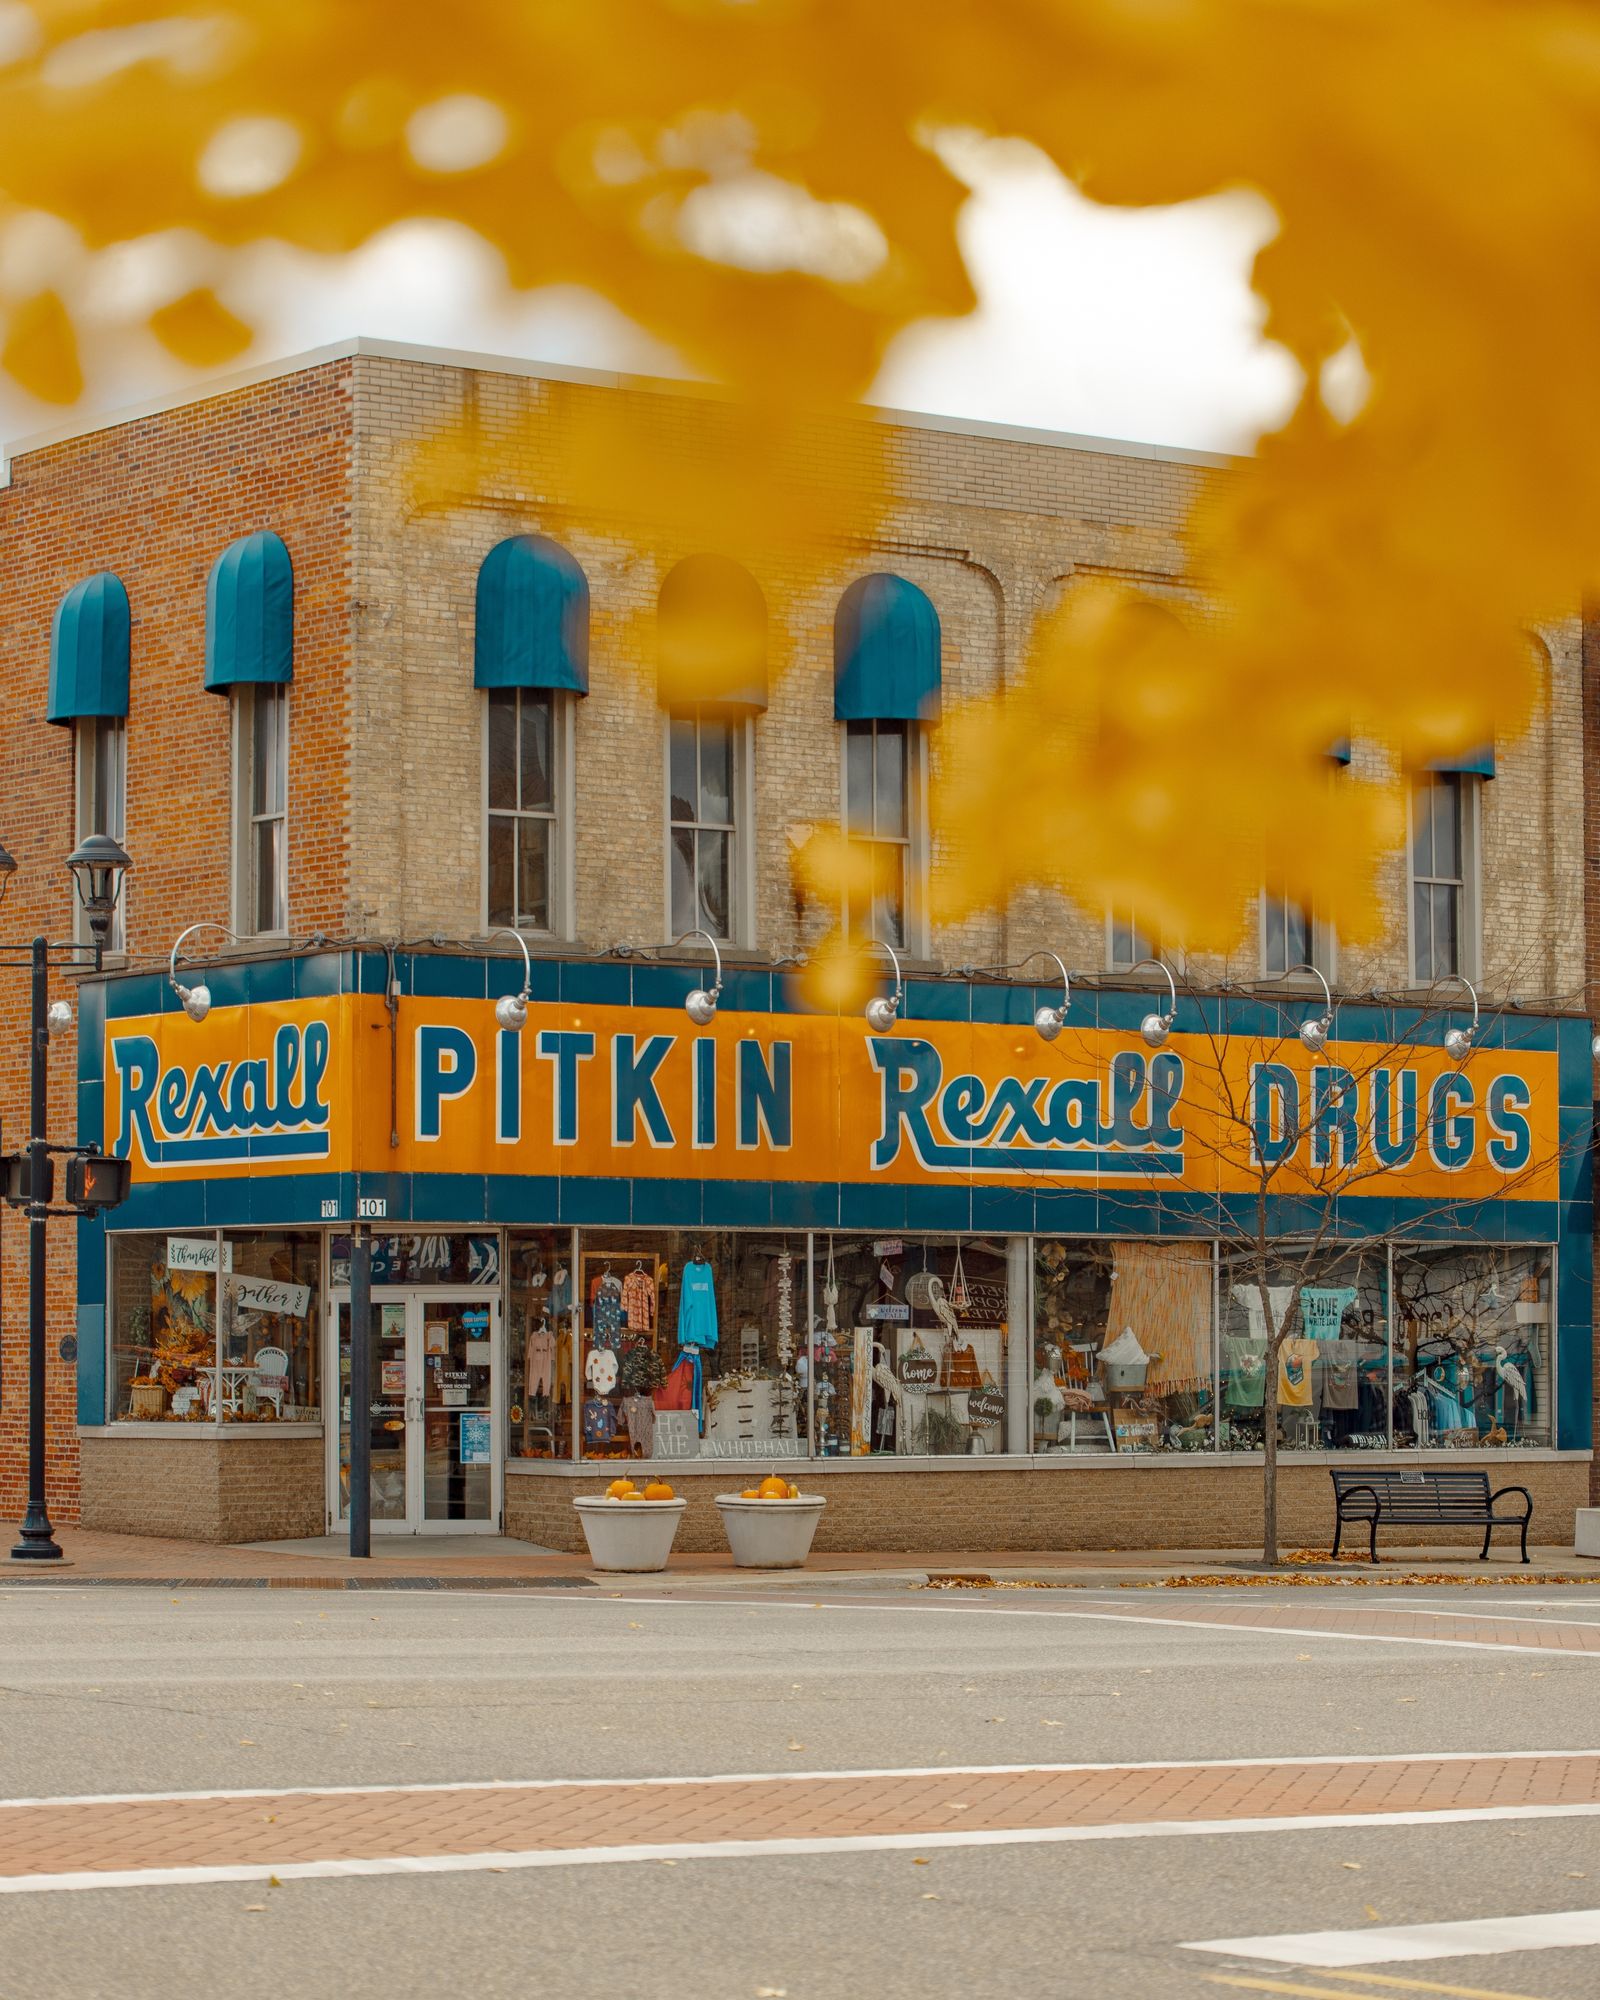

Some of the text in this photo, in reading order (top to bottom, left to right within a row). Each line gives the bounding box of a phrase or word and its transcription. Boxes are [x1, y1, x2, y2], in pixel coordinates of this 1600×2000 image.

[111, 1021, 330, 1168] Rexall
[415, 1025, 1531, 1177] PITKIN Rexall DRUGS
[321, 1199, 338, 1217] 101
[362, 1199, 384, 1215] 101
[1309, 1297, 1338, 1316] LOVE
[902, 1362, 934, 1380] home
[969, 1397, 1004, 1413] welcome
[712, 1440, 800, 1457] WHITEHALL
